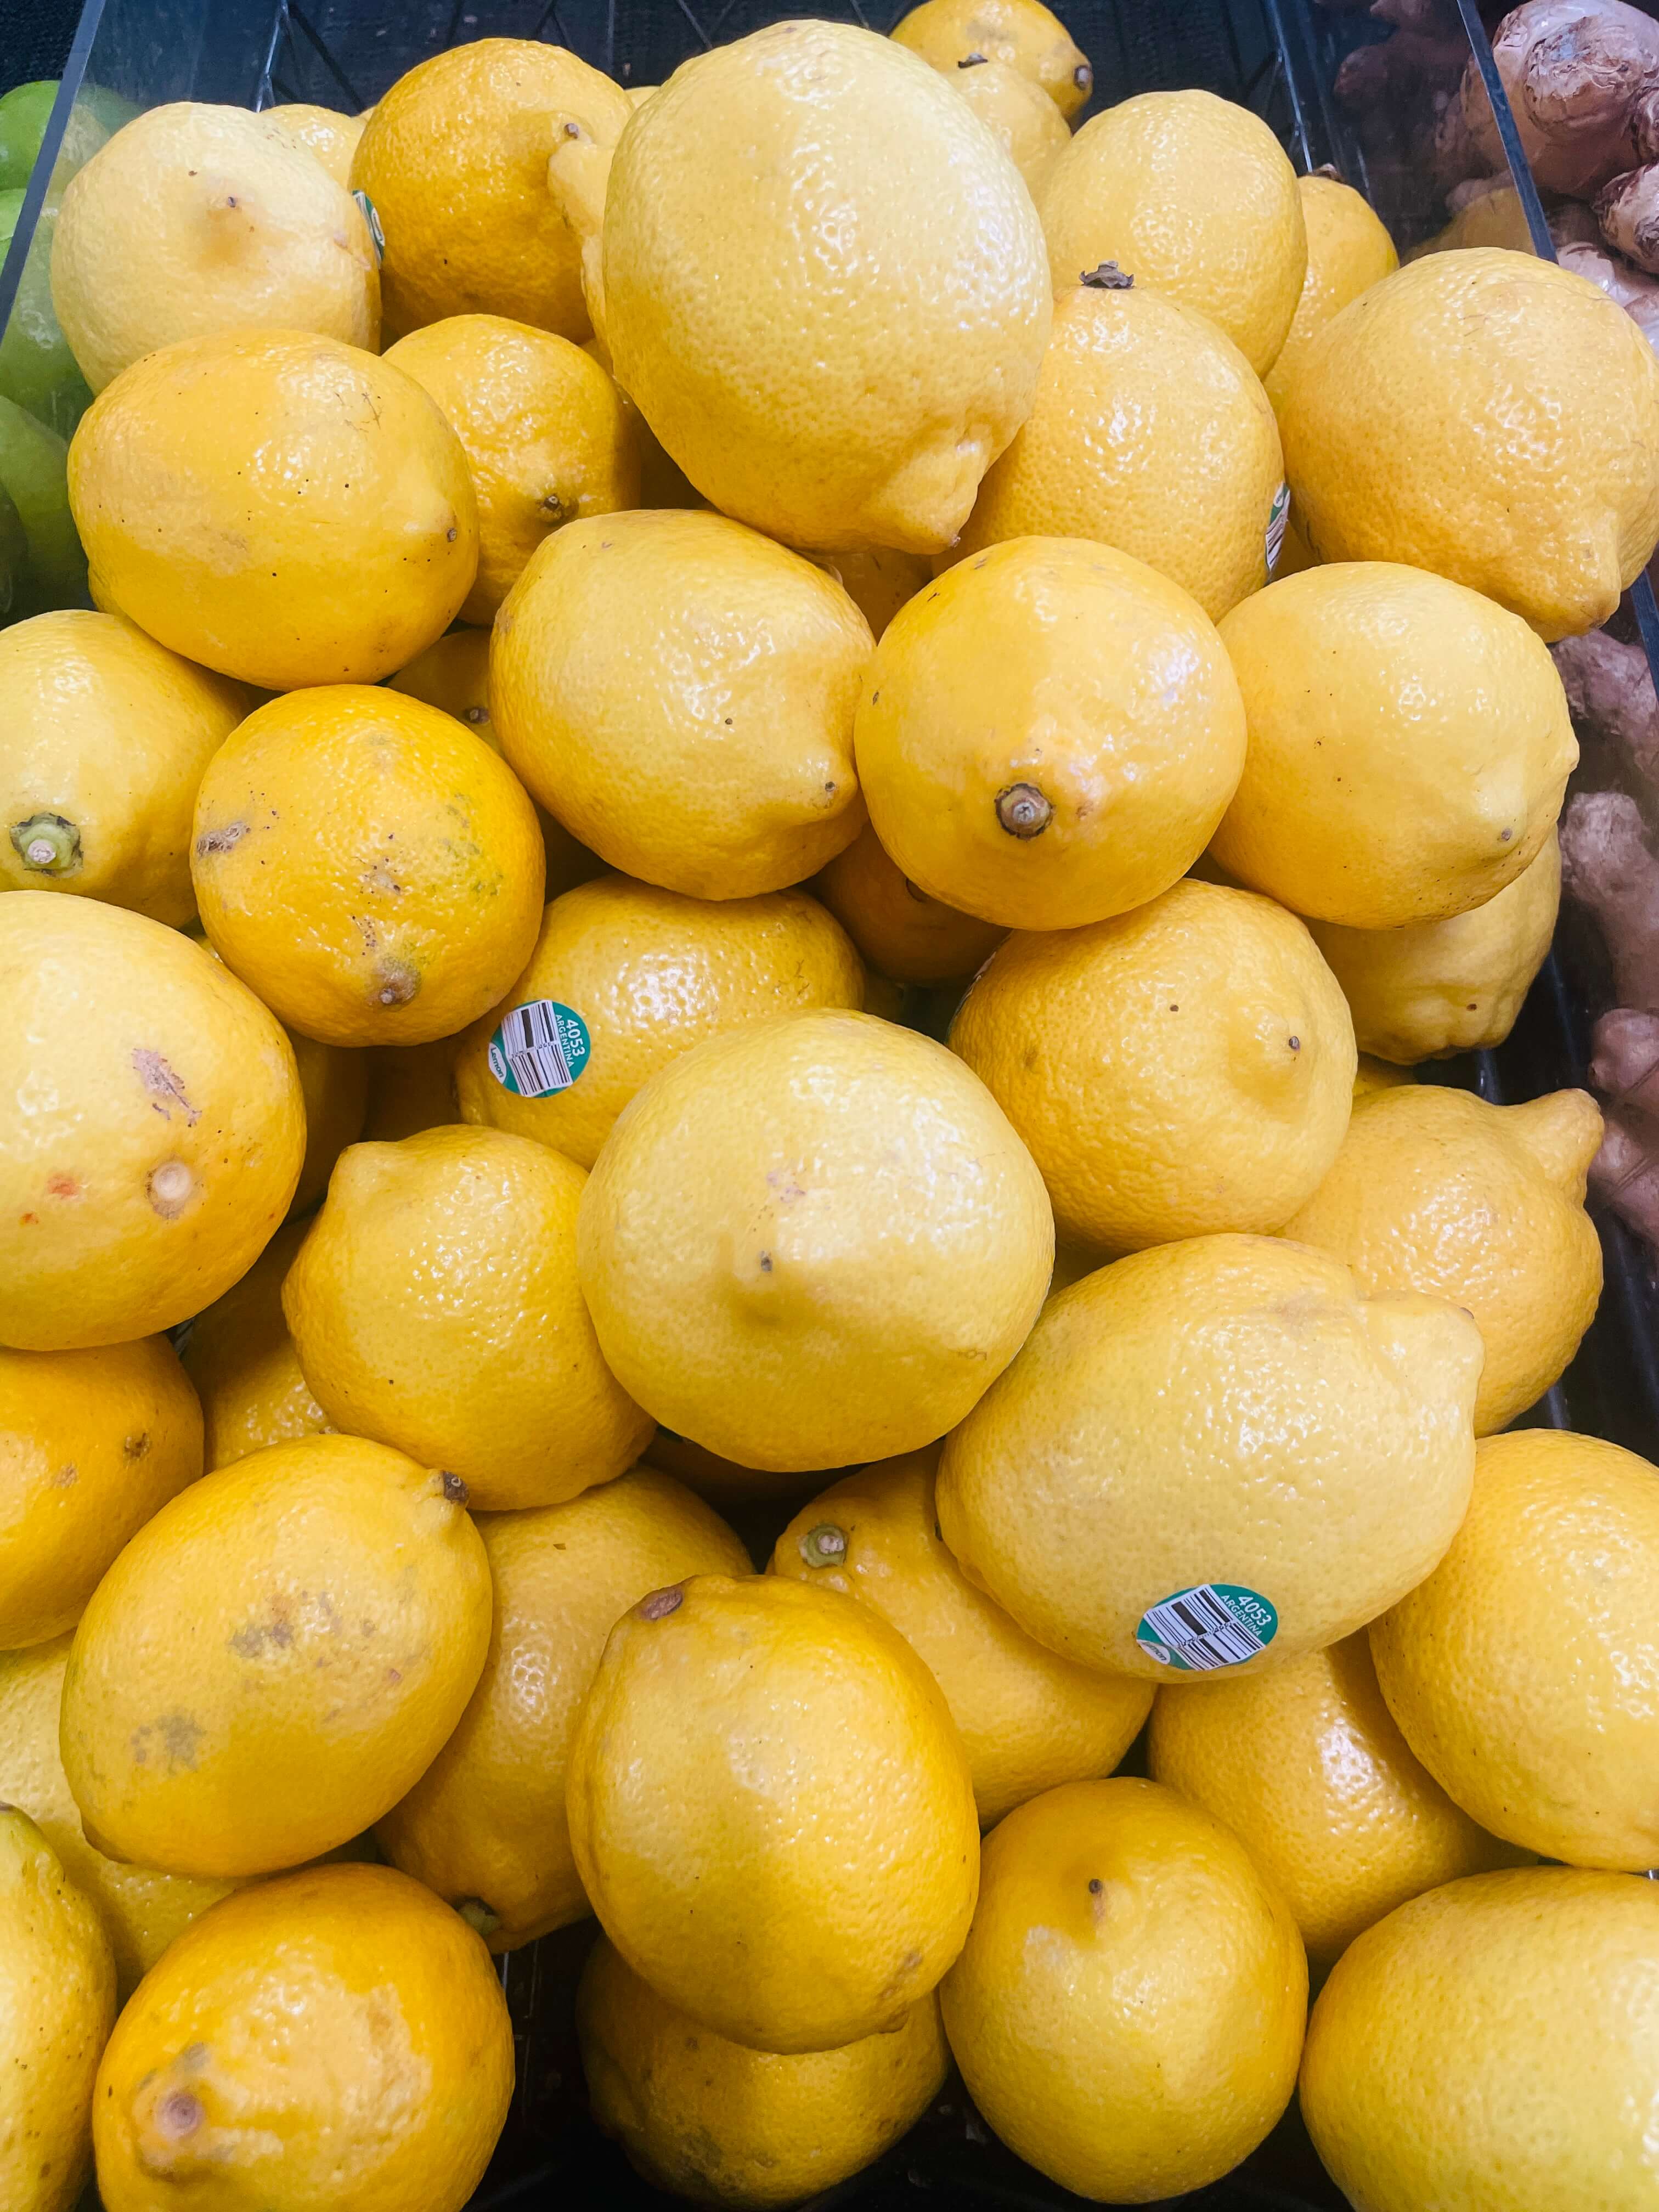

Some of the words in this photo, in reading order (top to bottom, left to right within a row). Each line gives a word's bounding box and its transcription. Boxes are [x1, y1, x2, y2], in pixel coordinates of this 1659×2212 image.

[555, 1014, 574, 1067] ARGENTINA
[566, 1019, 585, 1057] 4053
[491, 1047, 504, 1078] Lemon
[1221, 1595, 1263, 1637] ARGENTINA
[1238, 1595, 1272, 1626] 4053
